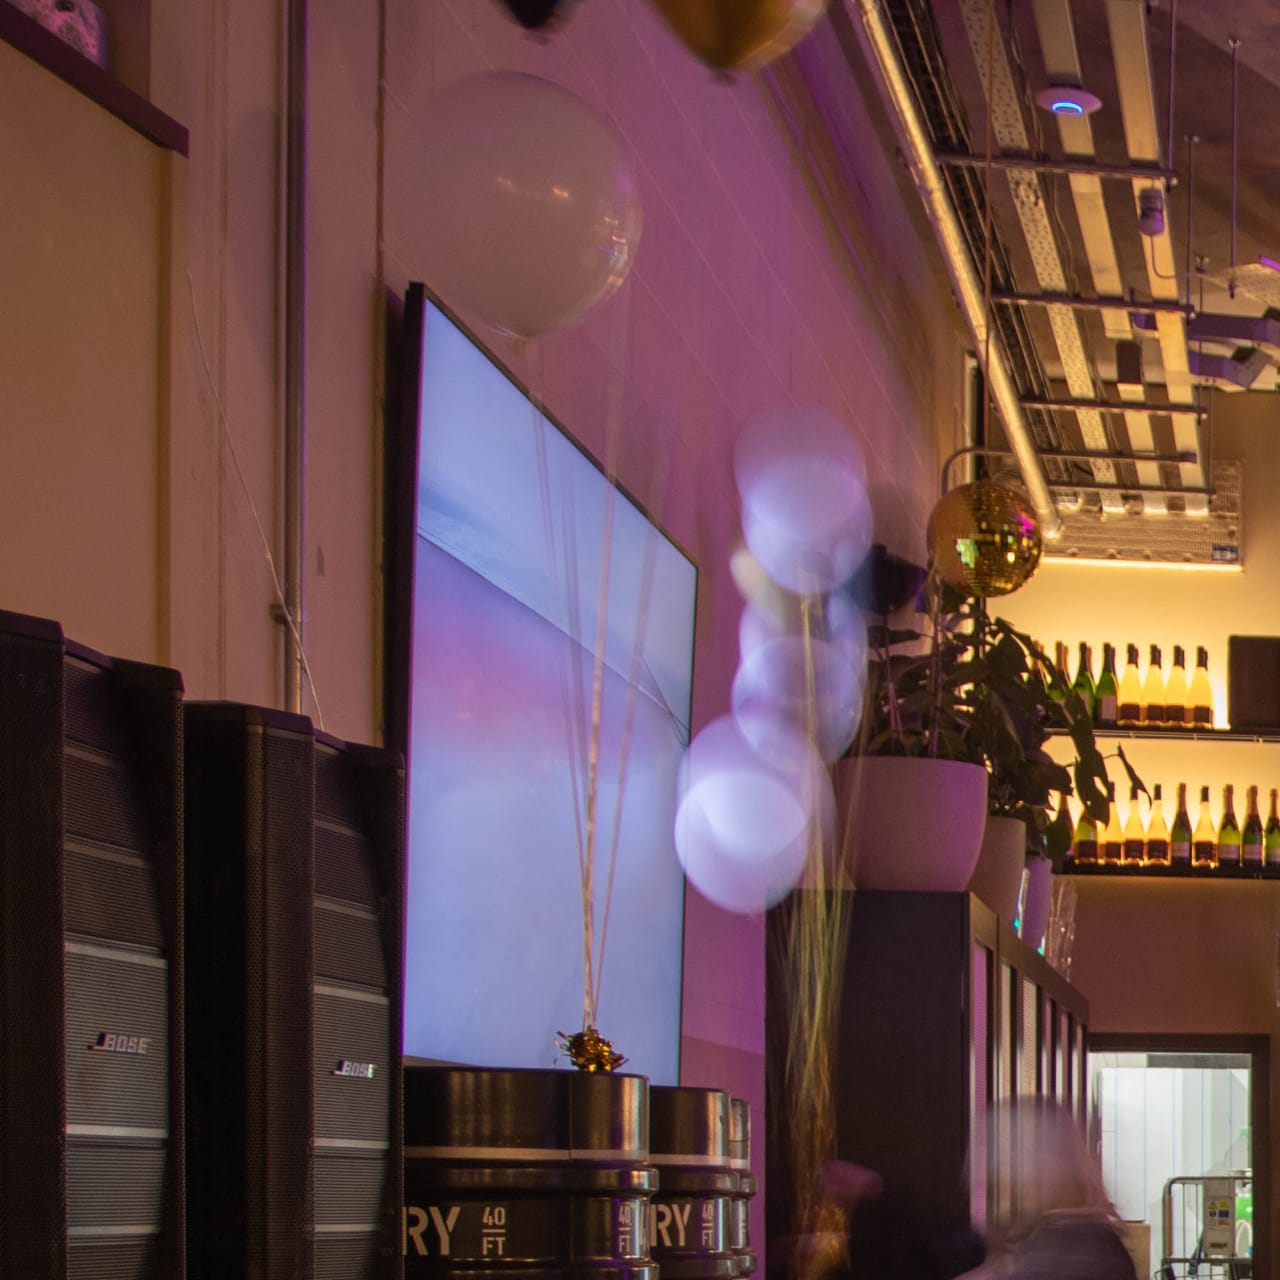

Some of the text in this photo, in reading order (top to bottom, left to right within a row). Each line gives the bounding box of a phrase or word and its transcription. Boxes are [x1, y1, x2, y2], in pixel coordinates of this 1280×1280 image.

[98, 1033, 150, 1054] BOSE
[482, 1206, 506, 1226] 40
[618, 1204, 632, 1225] 40
[701, 1202, 714, 1221] 40
[481, 1236, 506, 1256] FT
